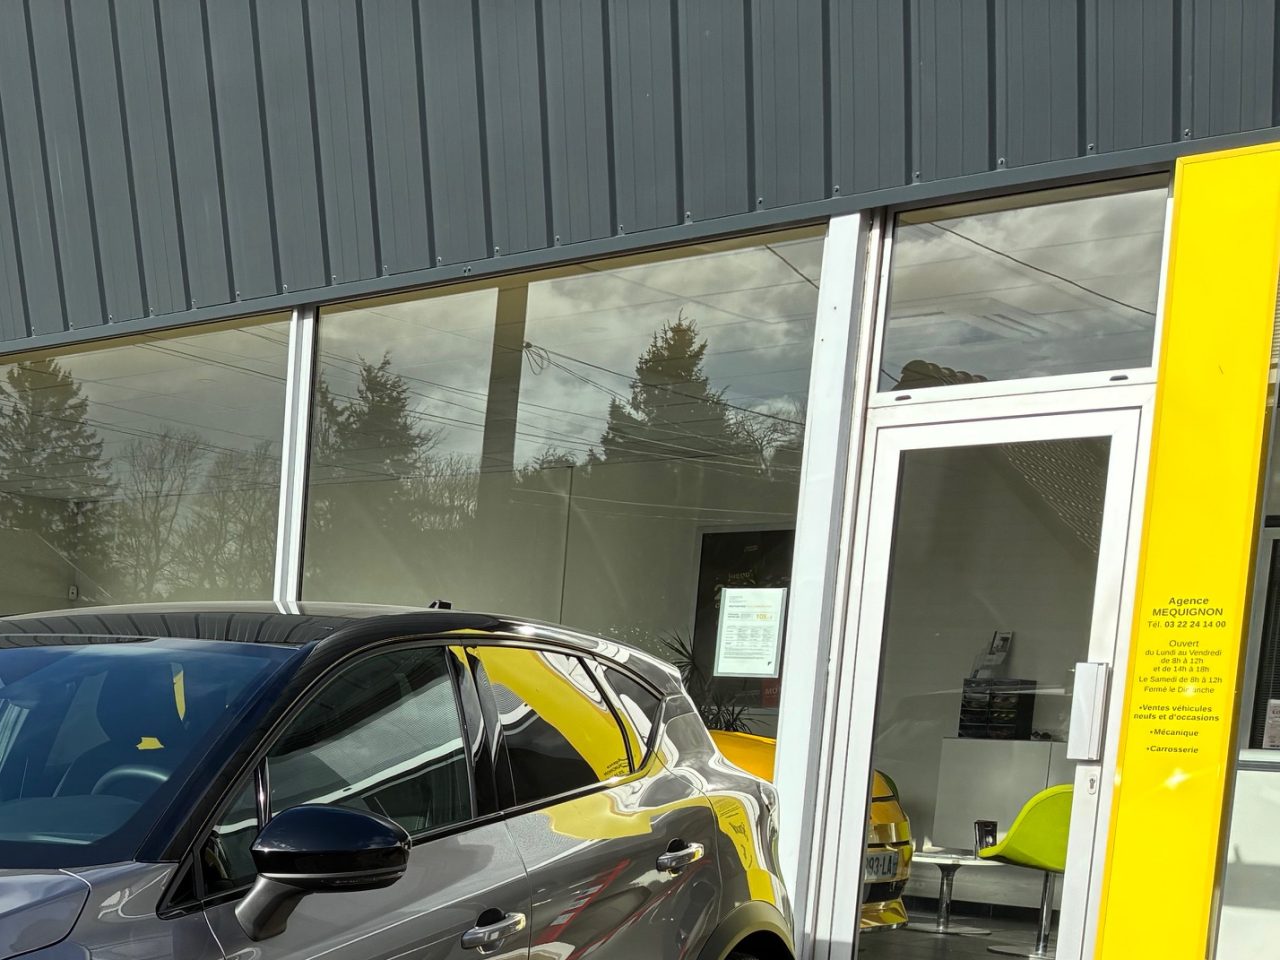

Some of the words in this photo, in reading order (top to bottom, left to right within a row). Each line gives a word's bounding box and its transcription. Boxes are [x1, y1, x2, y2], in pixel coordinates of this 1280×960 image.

[1168, 597, 1209, 607] Agence
[1152, 608, 1223, 618] MEQUIGNON
[1168, 713, 1220, 721] d'occasions
